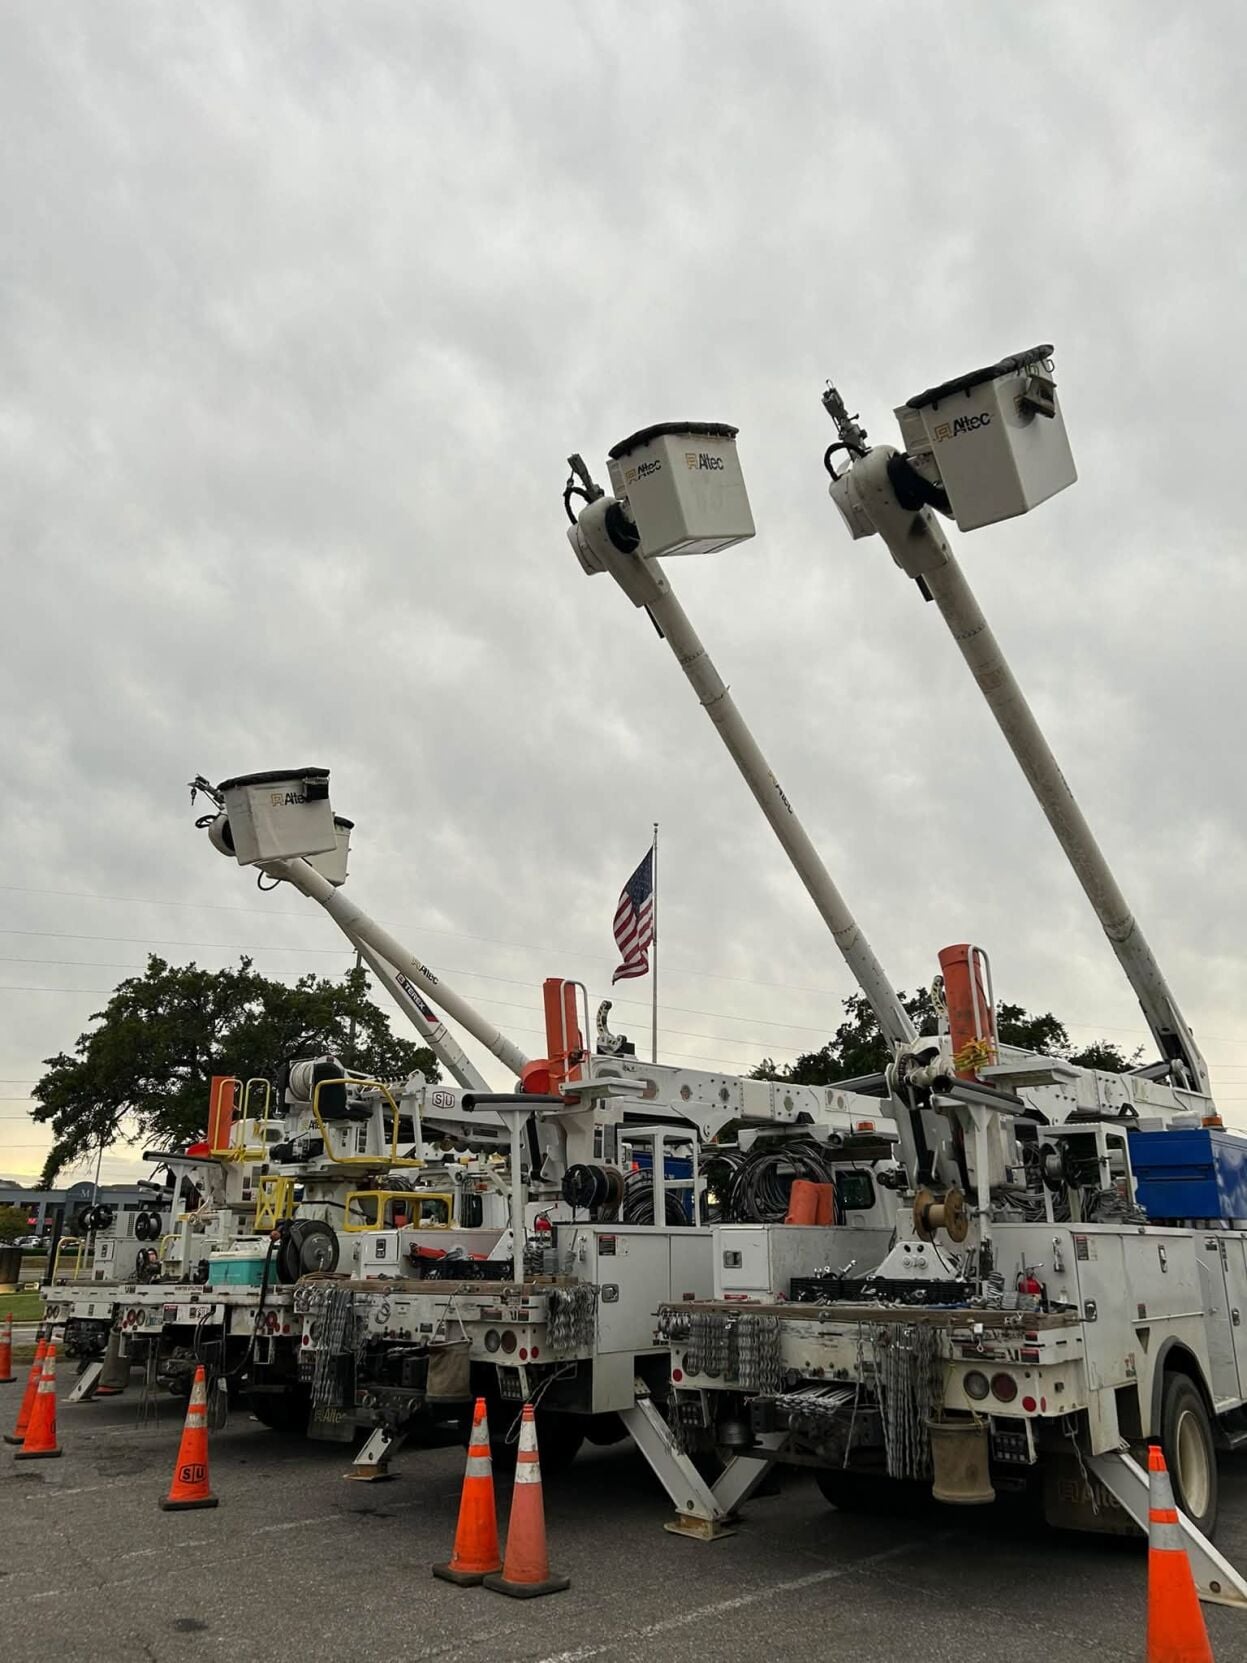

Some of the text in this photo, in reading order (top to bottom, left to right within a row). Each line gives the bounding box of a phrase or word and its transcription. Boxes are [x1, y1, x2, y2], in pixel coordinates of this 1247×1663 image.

[953, 412, 991, 437] Altec
[637, 460, 662, 480] Altec
[698, 453, 724, 470] Altec
[284, 792, 307, 806] Alte
[419, 965, 439, 985] Altec
[404, 982, 426, 1010] TEREX
